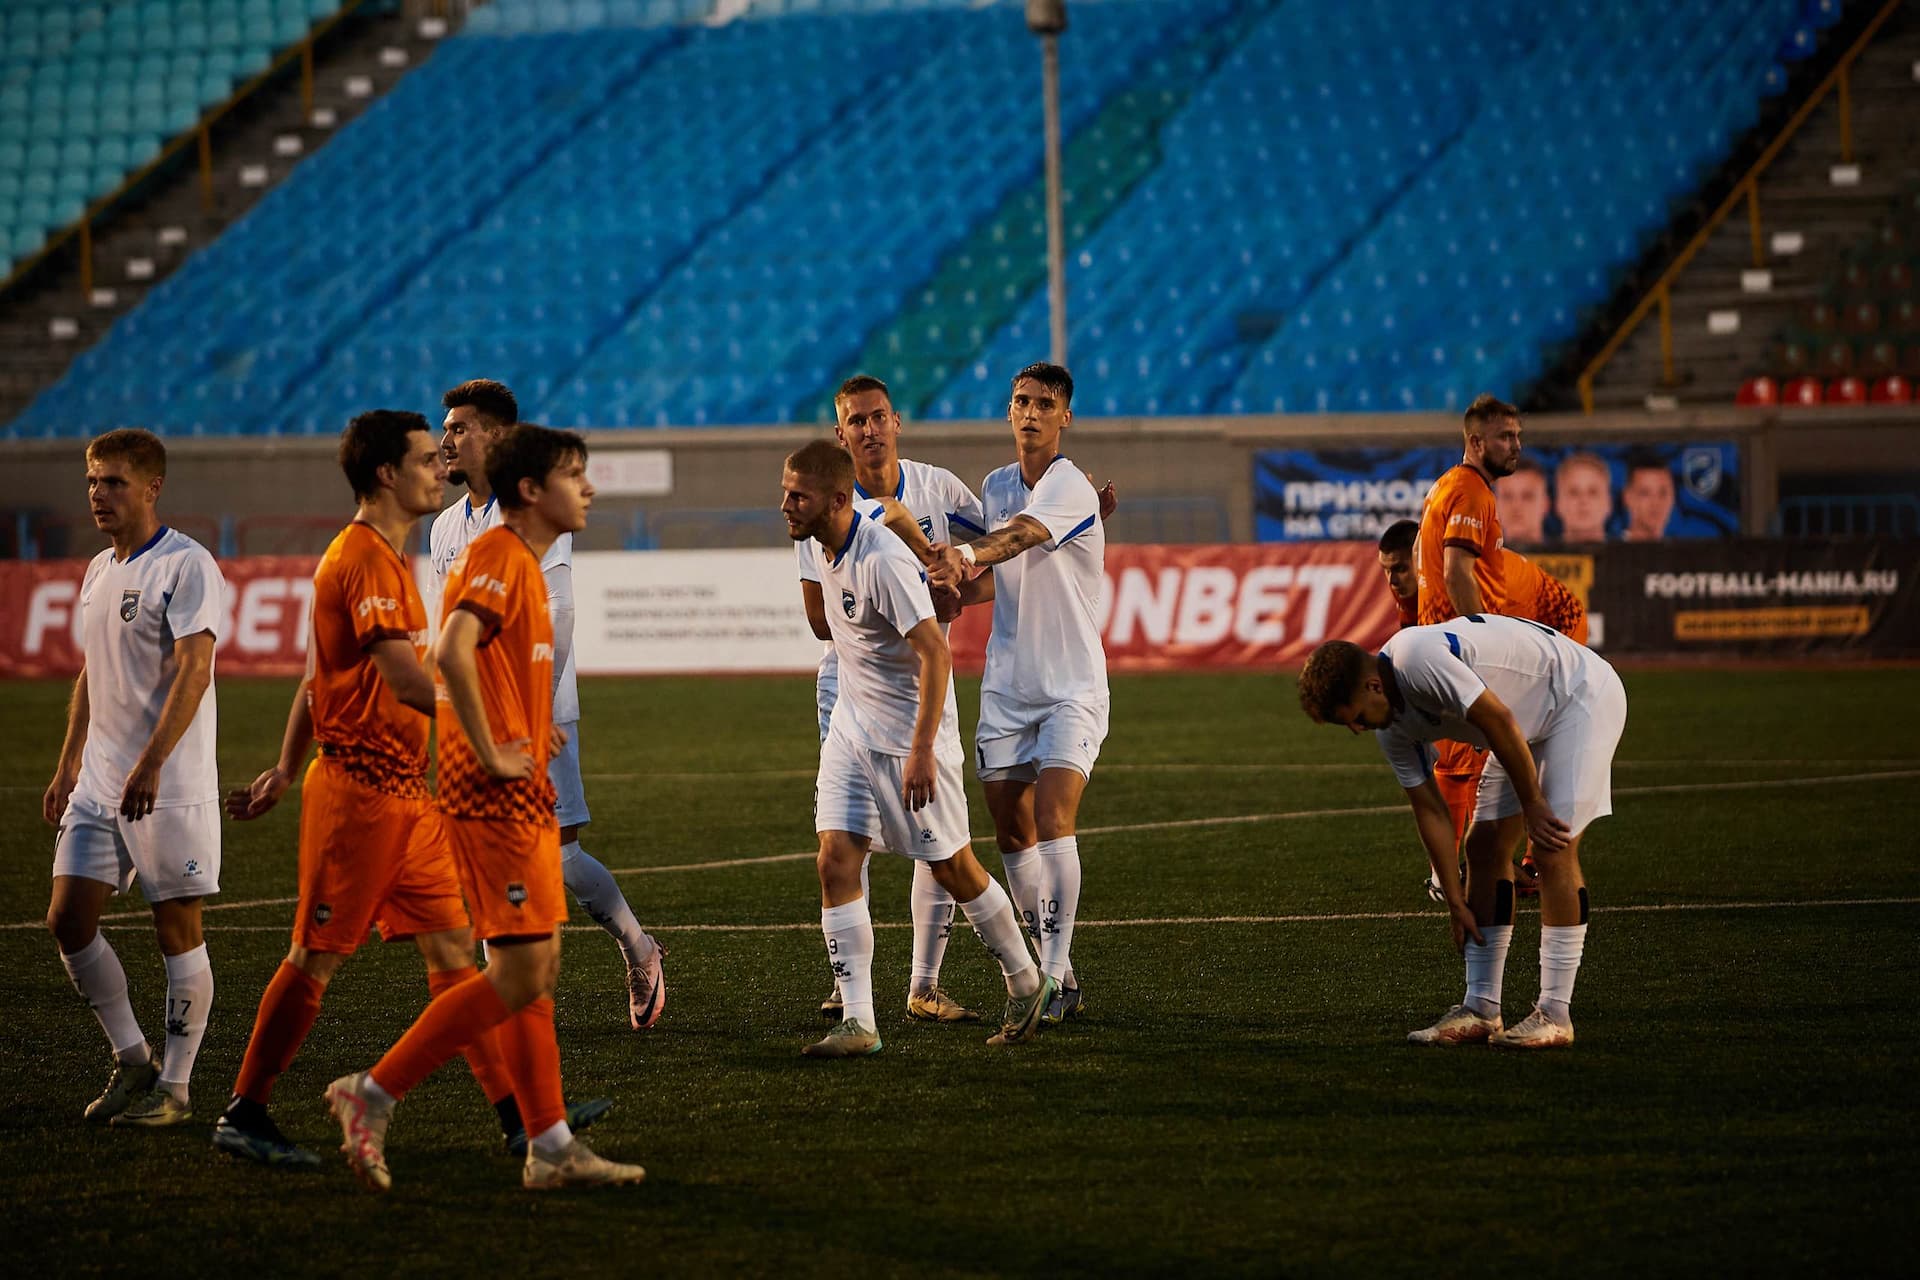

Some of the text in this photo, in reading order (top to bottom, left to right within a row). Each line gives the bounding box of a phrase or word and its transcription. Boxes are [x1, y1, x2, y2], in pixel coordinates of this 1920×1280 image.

[1284, 513, 1324, 538] НА
[1644, 570, 1898, 598] FOOTBALL-MANIA.RU
[1041, 899, 1059, 914] 10
[829, 938, 838, 955] 9
[168, 998, 192, 1016] 17
